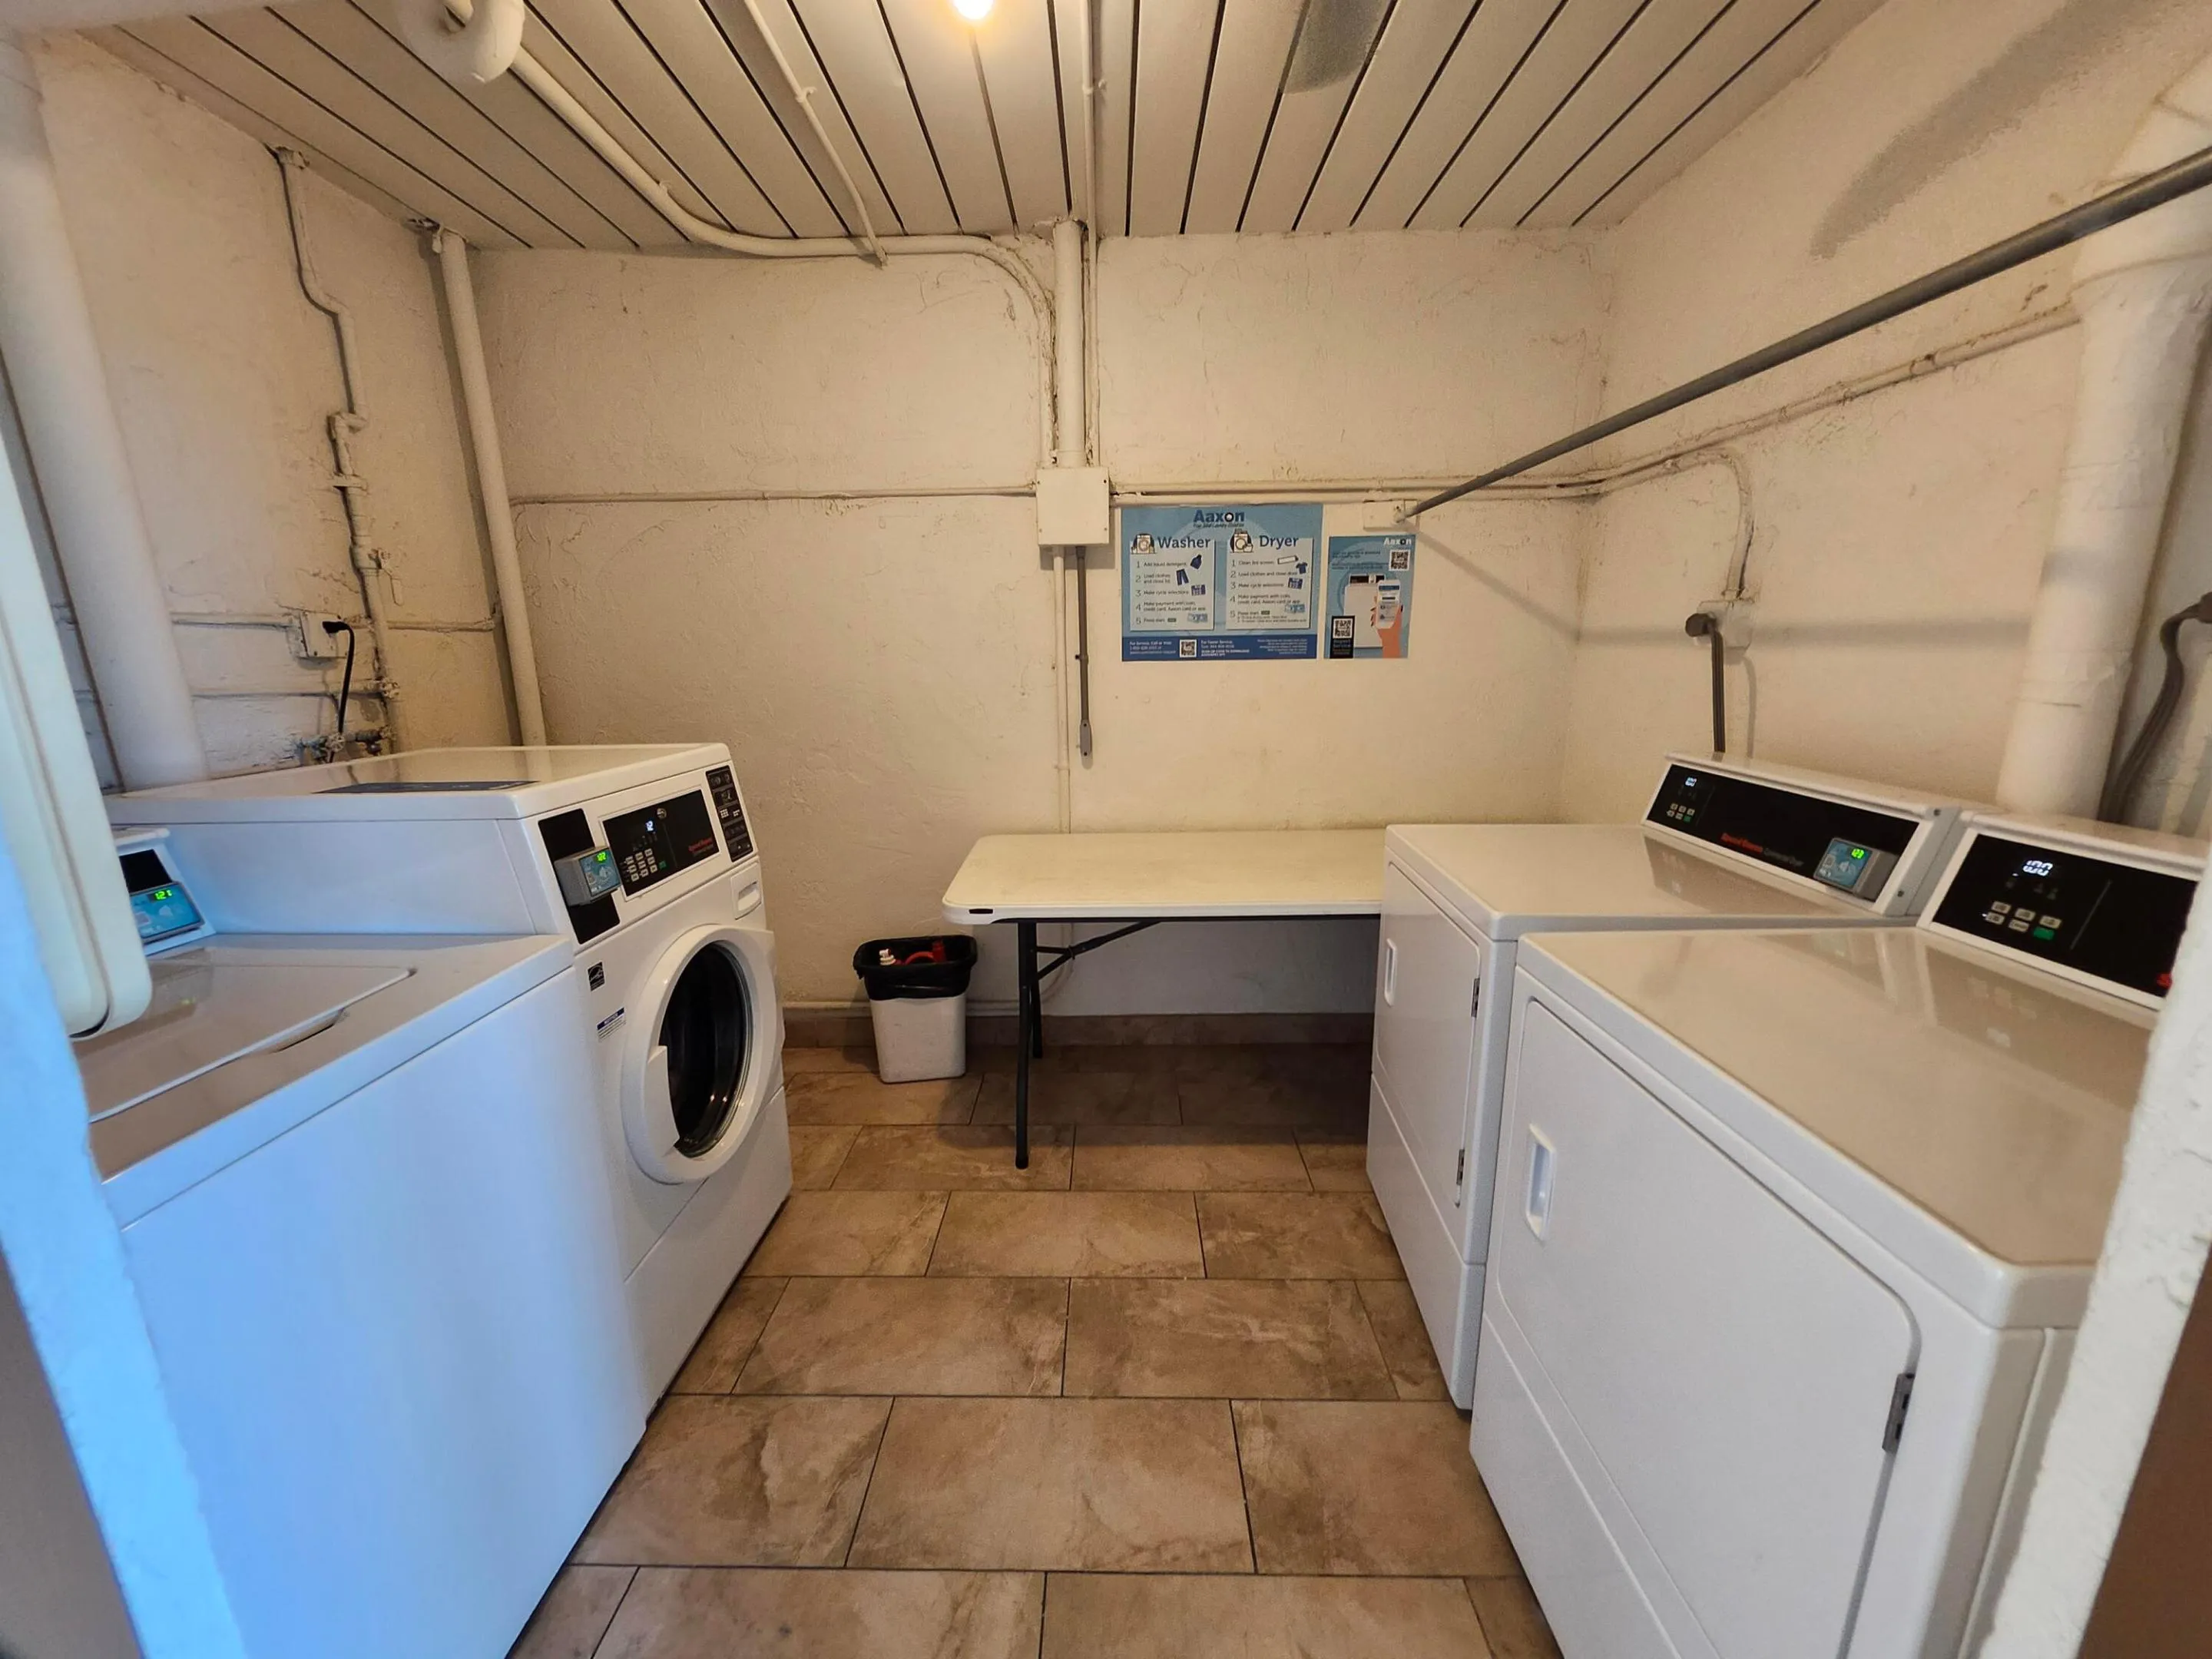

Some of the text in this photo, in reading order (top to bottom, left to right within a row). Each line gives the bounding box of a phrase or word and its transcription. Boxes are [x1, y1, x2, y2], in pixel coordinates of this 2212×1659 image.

[1194, 509, 1244, 522] Aaxon
[1157, 536, 1211, 548] Washer
[1260, 535, 1299, 550] Dryer
[1136, 575, 1141, 583] 2
